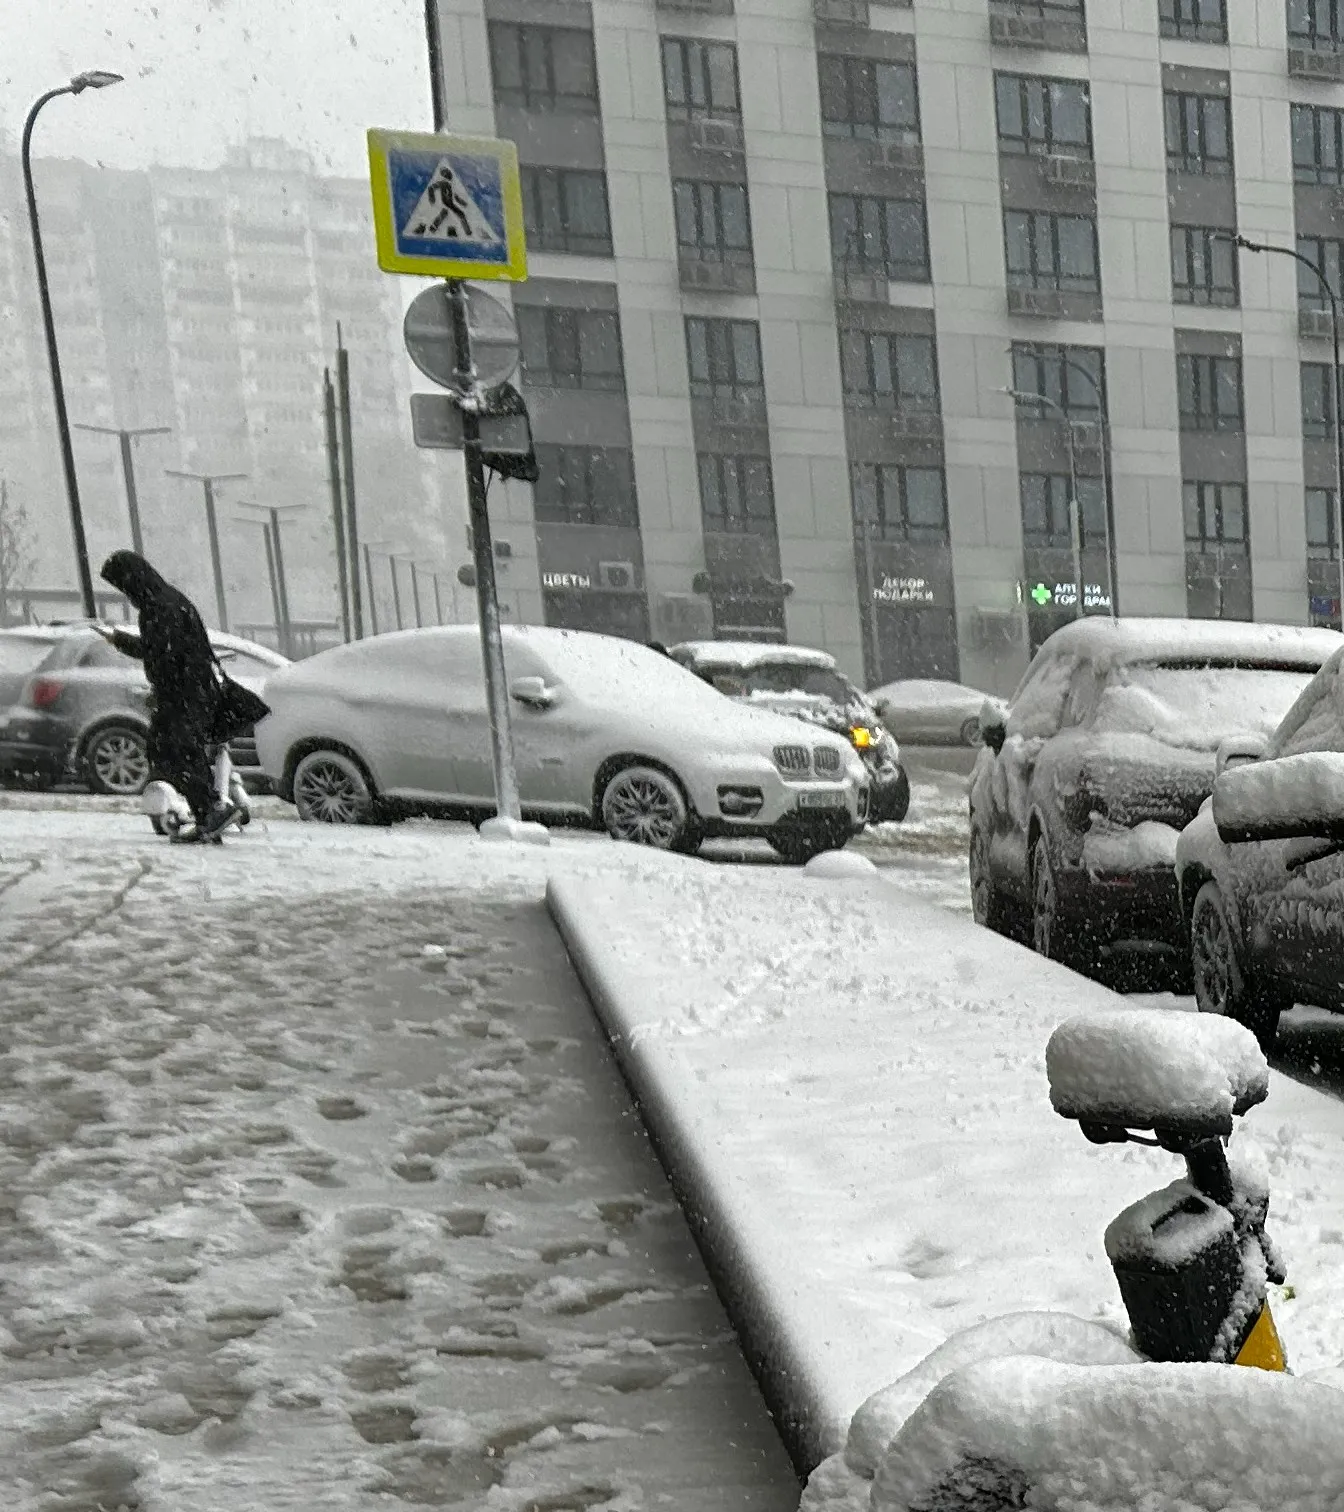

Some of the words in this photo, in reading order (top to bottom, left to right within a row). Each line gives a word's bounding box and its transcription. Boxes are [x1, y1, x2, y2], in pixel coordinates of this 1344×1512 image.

[543, 573, 591, 588] ЦВЕТЫ
[873, 588, 934, 601] ПОДАРКИ
[1054, 583, 1102, 595] АПТКИ
[1054, 594, 1111, 607] ГОРДРА
